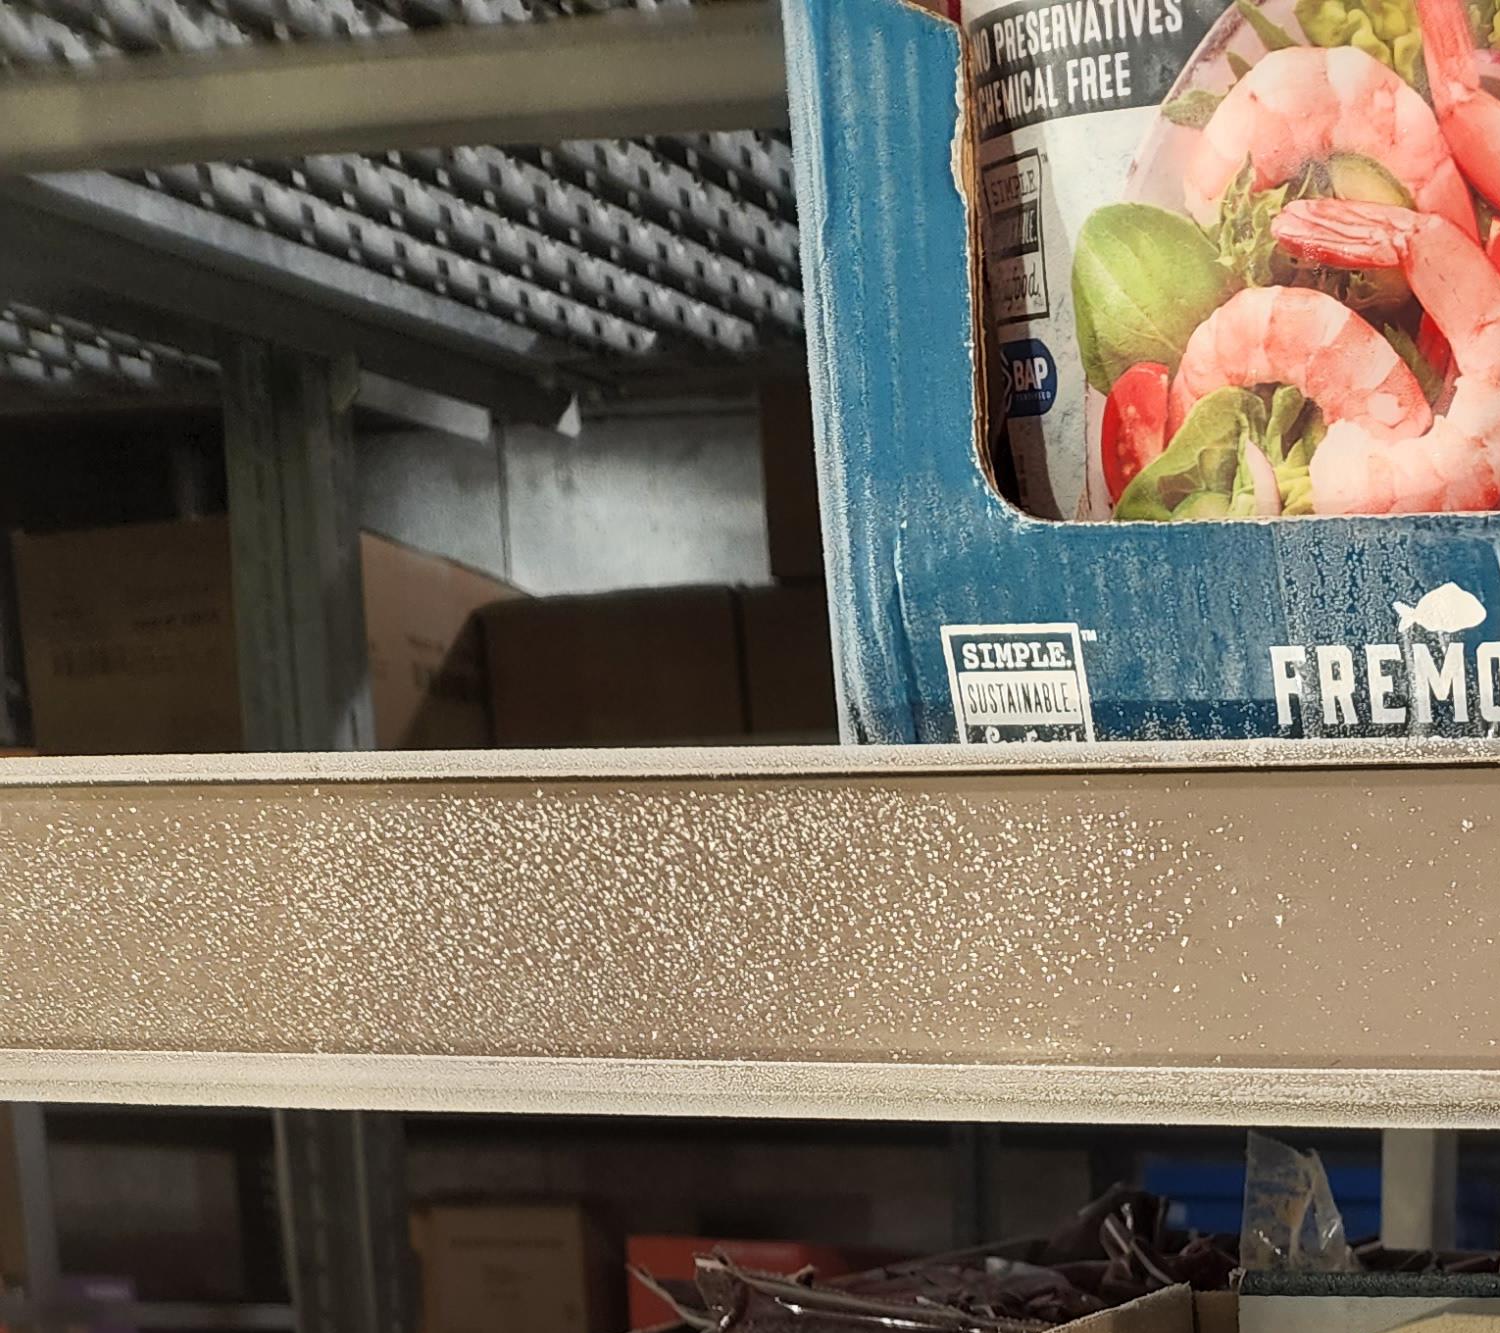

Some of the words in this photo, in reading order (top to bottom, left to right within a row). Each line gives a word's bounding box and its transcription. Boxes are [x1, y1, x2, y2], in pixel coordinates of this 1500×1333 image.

[973, 27, 991, 73] NO
[994, 0, 1184, 64] PRESERVATIVES
[978, 64, 1059, 127] CHEMICAL
[1066, 52, 1132, 103] FREE
[1013, 357, 1048, 391] BAP
